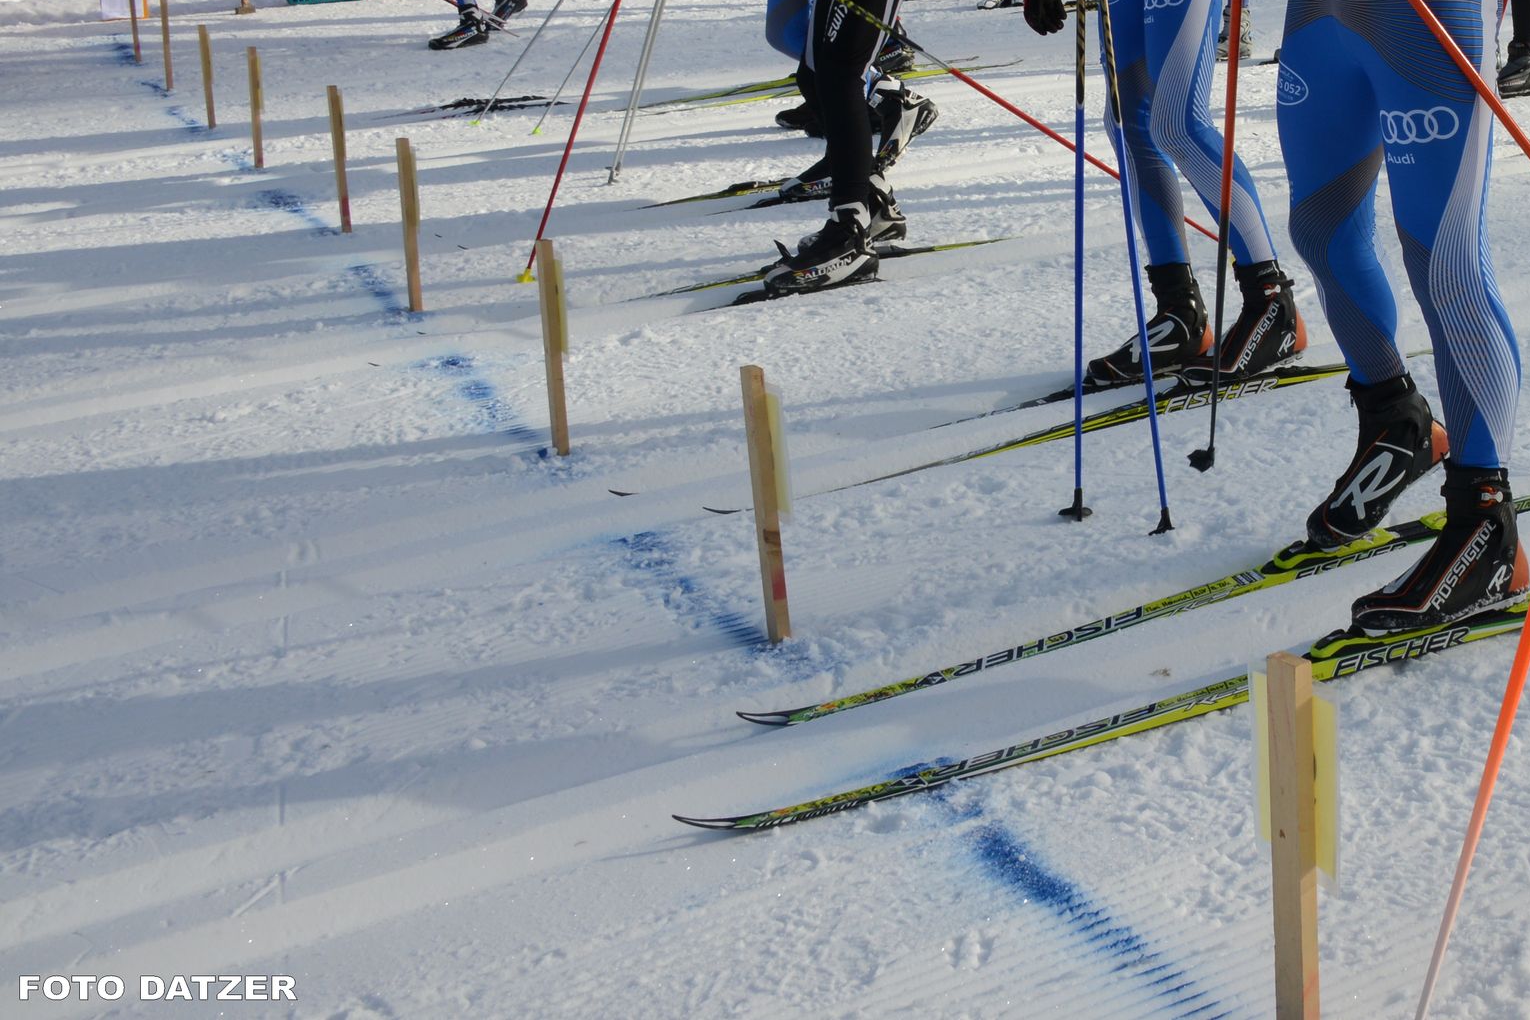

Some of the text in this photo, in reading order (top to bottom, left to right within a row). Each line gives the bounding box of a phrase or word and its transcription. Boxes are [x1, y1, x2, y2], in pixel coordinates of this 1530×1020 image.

[1386, 152, 1416, 166] Audi
[796, 255, 853, 284] SALOMON
[1237, 301, 1280, 370] ROSSIGNOL
[1164, 377, 1279, 414] FISCHER
[1430, 519, 1497, 611] ROSSIGNOL
[1332, 626, 1471, 680] FISCHER
